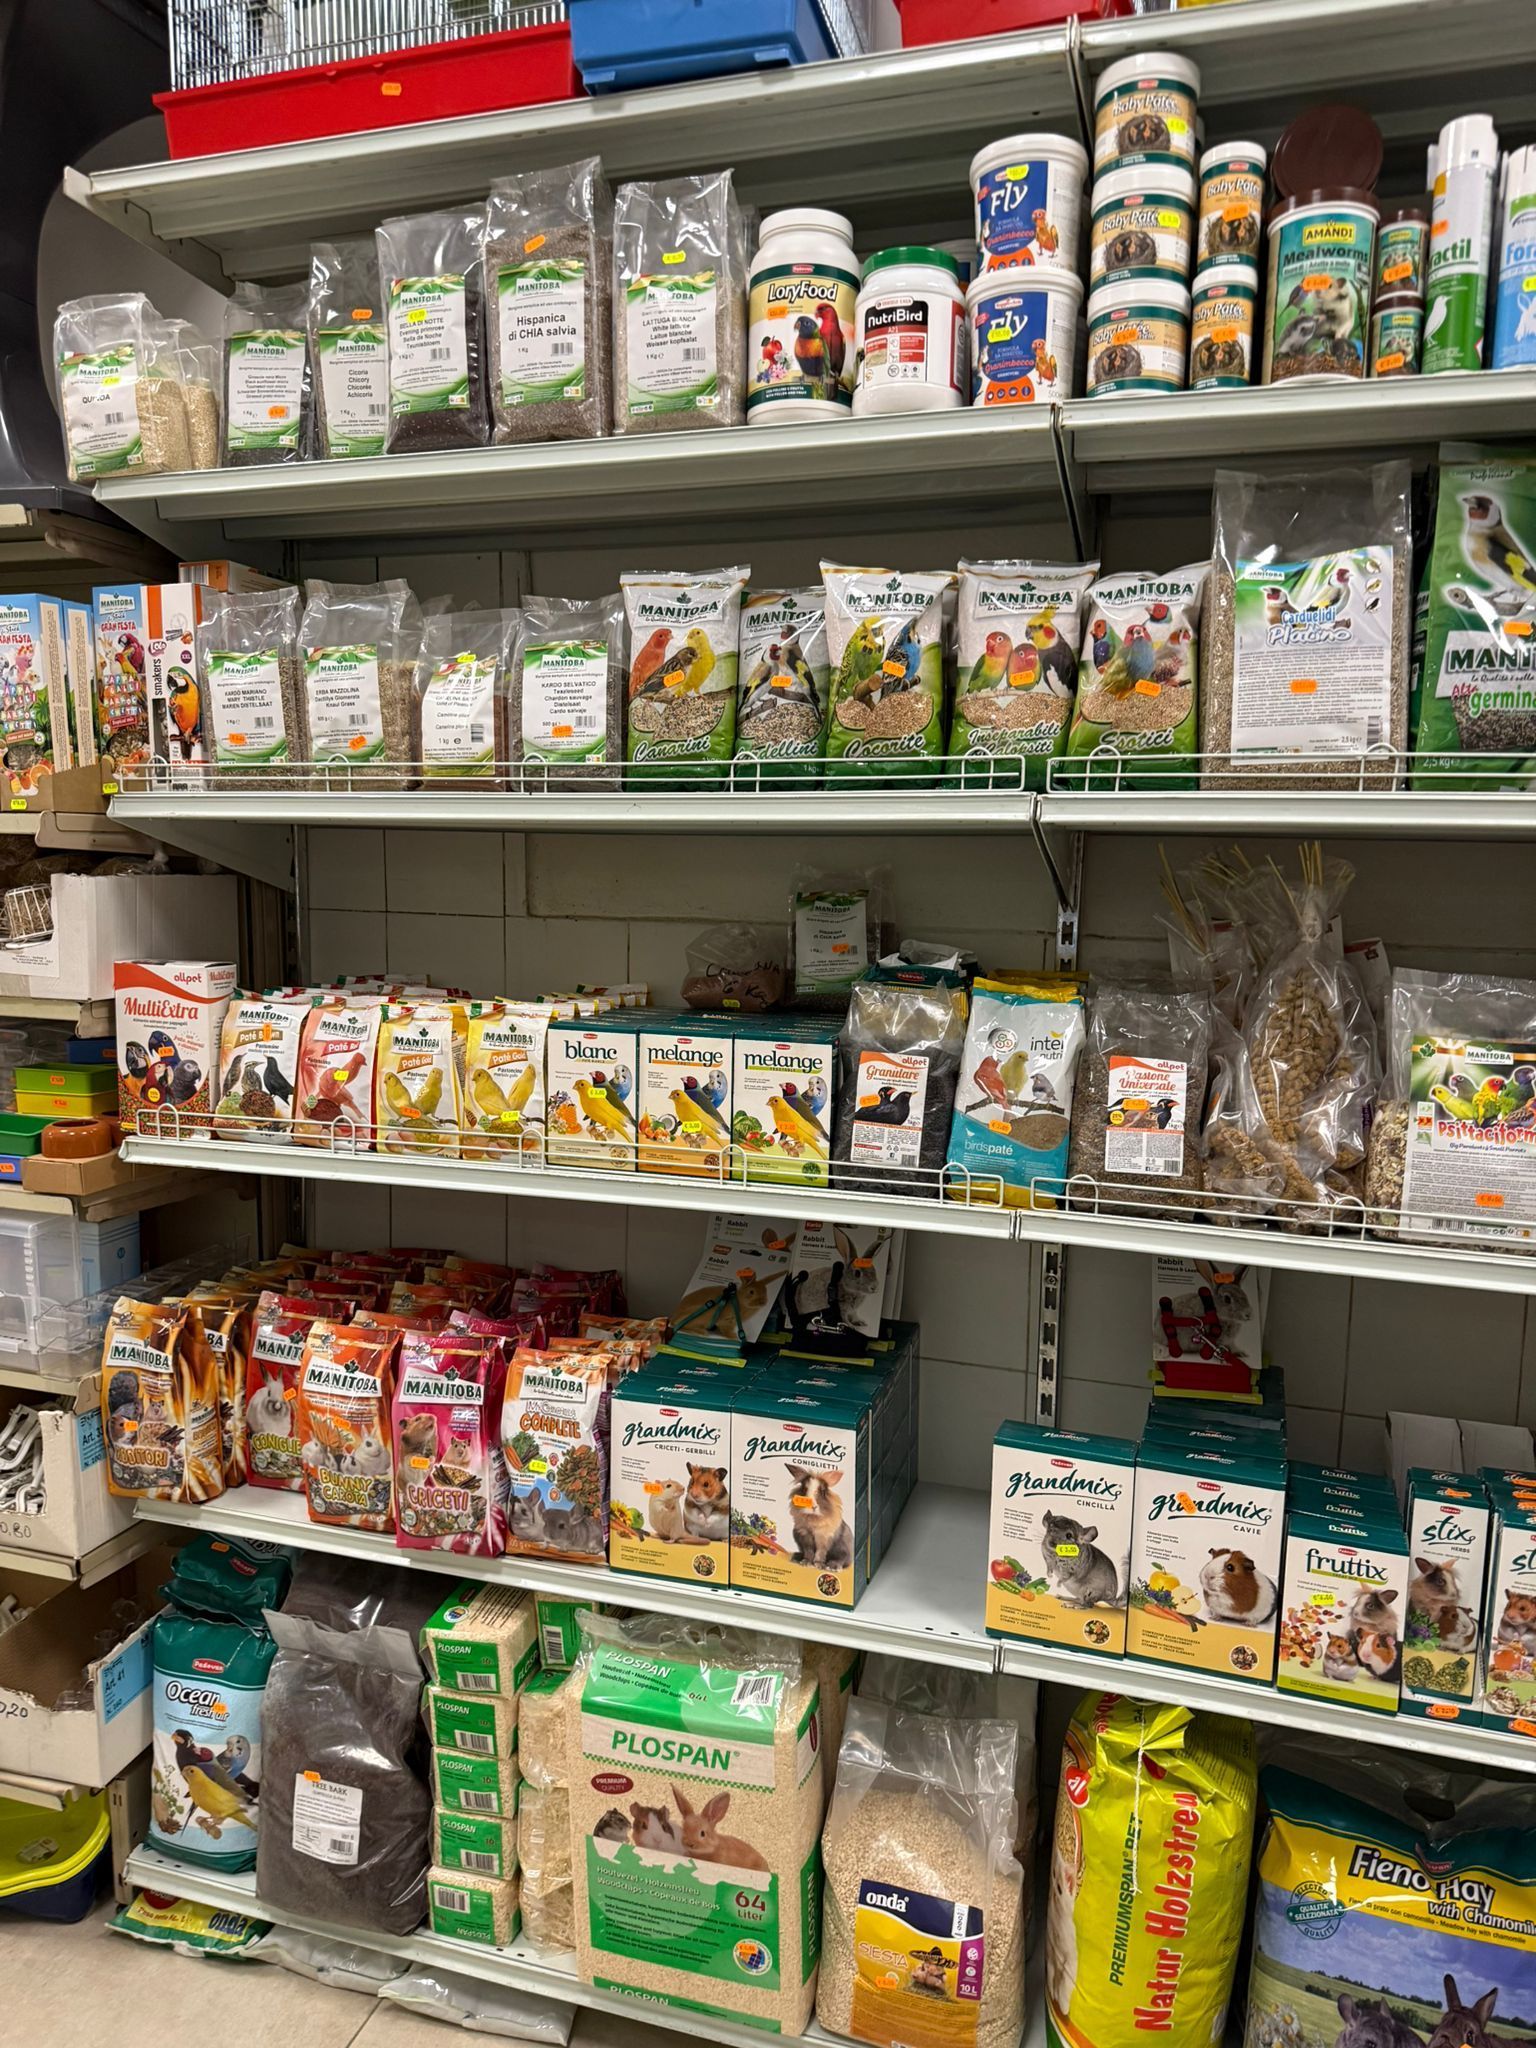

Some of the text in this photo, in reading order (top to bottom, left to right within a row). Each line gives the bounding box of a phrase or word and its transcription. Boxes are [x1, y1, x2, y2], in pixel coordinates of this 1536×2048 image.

[990, 181, 1029, 217] Fly
[1102, 214, 1131, 234] Baby
[518, 280, 561, 293] MANITOBA
[767, 279, 838, 303] LoryFood
[402, 295, 442, 306] MANITOBA
[424, 317, 443, 325] NOTTE
[516, 313, 566, 328] Hispanica
[868, 308, 924, 328] nutriBird
[420, 325, 445, 335] primrose
[424, 331, 442, 340] Noche
[508, 325, 577, 341] di CHIA salvia
[246, 346, 286, 356] MANITOBA
[338, 345, 376, 353] MANITOBA
[79, 367, 120, 376] MANITOBA
[348, 376, 370, 384] Chicory
[347, 391, 373, 399] Achicoria
[980, 590, 1073, 604] MANITOBA
[1096, 582, 1195, 601] MANITOBA
[100, 597, 134, 609] MANITOBA
[639, 600, 720, 618] MANITOBA
[1280, 607, 1337, 625] Carduelidi
[117, 621, 136, 632] FESTA
[1265, 622, 1352, 647] Platino
[223, 665, 259, 675] MANITOBA
[320, 663, 358, 674] MANITOBA
[543, 658, 585, 668] MANITOBA
[154, 657, 163, 697] smakers
[563, 680, 597, 688] SELVATICO
[243, 694, 265, 702] THISTLE
[329, 687, 360, 695] MAZZOLINA
[1452, 683, 1480, 698] Alta
[967, 721, 1061, 746] Inseparabili
[633, 734, 711, 763] Canarini
[844, 732, 925, 760] Cocorite
[815, 904, 851, 914] MANITOBA
[123, 996, 200, 1020] MultiExtra
[239, 1031, 257, 1042] Paté
[393, 1036, 440, 1049] MANITOBA
[484, 1032, 534, 1045] MANITOBA
[328, 1043, 348, 1052] Paté
[563, 1039, 618, 1060] blanc
[401, 1057, 420, 1068] Paté
[492, 1053, 512, 1065] Paté
[646, 1044, 724, 1068] melange
[743, 1050, 824, 1074] melange
[901, 1056, 928, 1068] allpet
[1466, 1051, 1512, 1061] MANITOBA
[865, 1064, 920, 1081] Granulare
[1157, 1061, 1186, 1072] allpet
[1118, 1078, 1177, 1092] Universale
[964, 1139, 1014, 1157] birdspaté
[803, 1234, 826, 1244] Rabbit
[1157, 1257, 1184, 1266] Rabbit
[110, 1344, 170, 1368] MANITOBA
[306, 1369, 378, 1393] MANITOBA
[525, 1373, 585, 1395] MANITOBA
[403, 1380, 483, 1401] MANITOBA
[519, 1413, 582, 1439] COMPLETE
[621, 1418, 721, 1447] grandmix
[82, 1432, 97, 1447] Art.
[654, 1443, 716, 1456] CRICETI GERBILLI
[743, 1433, 847, 1463] grandmix
[792, 1457, 839, 1471] CONIGLIETTI
[319, 1467, 373, 1491] BUNNY
[1004, 1469, 1123, 1501] grandmix
[322, 1484, 369, 1508] CAROTA
[407, 1485, 470, 1512] CRICETI
[1325, 1504, 1365, 1517] fruttix
[1233, 1525, 1262, 1536] CAVIE
[1329, 1524, 1368, 1537] fruttix
[1421, 1515, 1477, 1546] stix
[1305, 1546, 1389, 1583] fruttix
[437, 1642, 472, 1655] PLOSPAN
[194, 1659, 224, 1672] Padovan
[604, 1650, 672, 1679] PLOSPAN
[104, 1669, 125, 1696] Art. 41
[599, 1671, 660, 1693] Woodchips Copeaux
[165, 1681, 221, 1707] Ocean
[436, 1700, 470, 1715] PLOSPAN
[610, 1729, 732, 1772] PLOSPAN
[440, 1759, 473, 1773] PLOSPAN
[595, 1777, 627, 1785] PREMIUM
[601, 1784, 626, 1792] QUALITY
[329, 1784, 348, 1797] BARK
[442, 1818, 477, 1834] PLOSPAN
[596, 1865, 700, 1896] Houtvezel Holzeinstreu
[1347, 1843, 1496, 1914] Fieno Hay
[597, 1876, 721, 1912] Woodchips Copeaux de Bois
[734, 1890, 767, 1913] 64
[865, 1890, 908, 1914] onda
[737, 1909, 764, 1922] Liter
[807, 1871, 817, 1958] PLOSPAN
[1133, 1791, 1202, 2033] Natur Holzstreu
[1427, 1901, 1460, 1922] with
[208, 1910, 249, 1937] onda
[1108, 1857, 1136, 1988] PREMIUMSPAN
[1372, 1904, 1390, 1914] prato
[1402, 1910, 1435, 1925] camomilla
[1439, 1919, 1465, 1930] Meadow
[1465, 1926, 1478, 1936] hay
[1478, 1928, 1491, 1937] with
[1491, 1930, 1527, 1945] chamomile
[456, 1925, 492, 1941] PLOSPAN
[1302, 1923, 1336, 1939] QUALITY
[857, 1941, 910, 1970] SIESTA
[959, 1983, 978, 1995] 10 L
